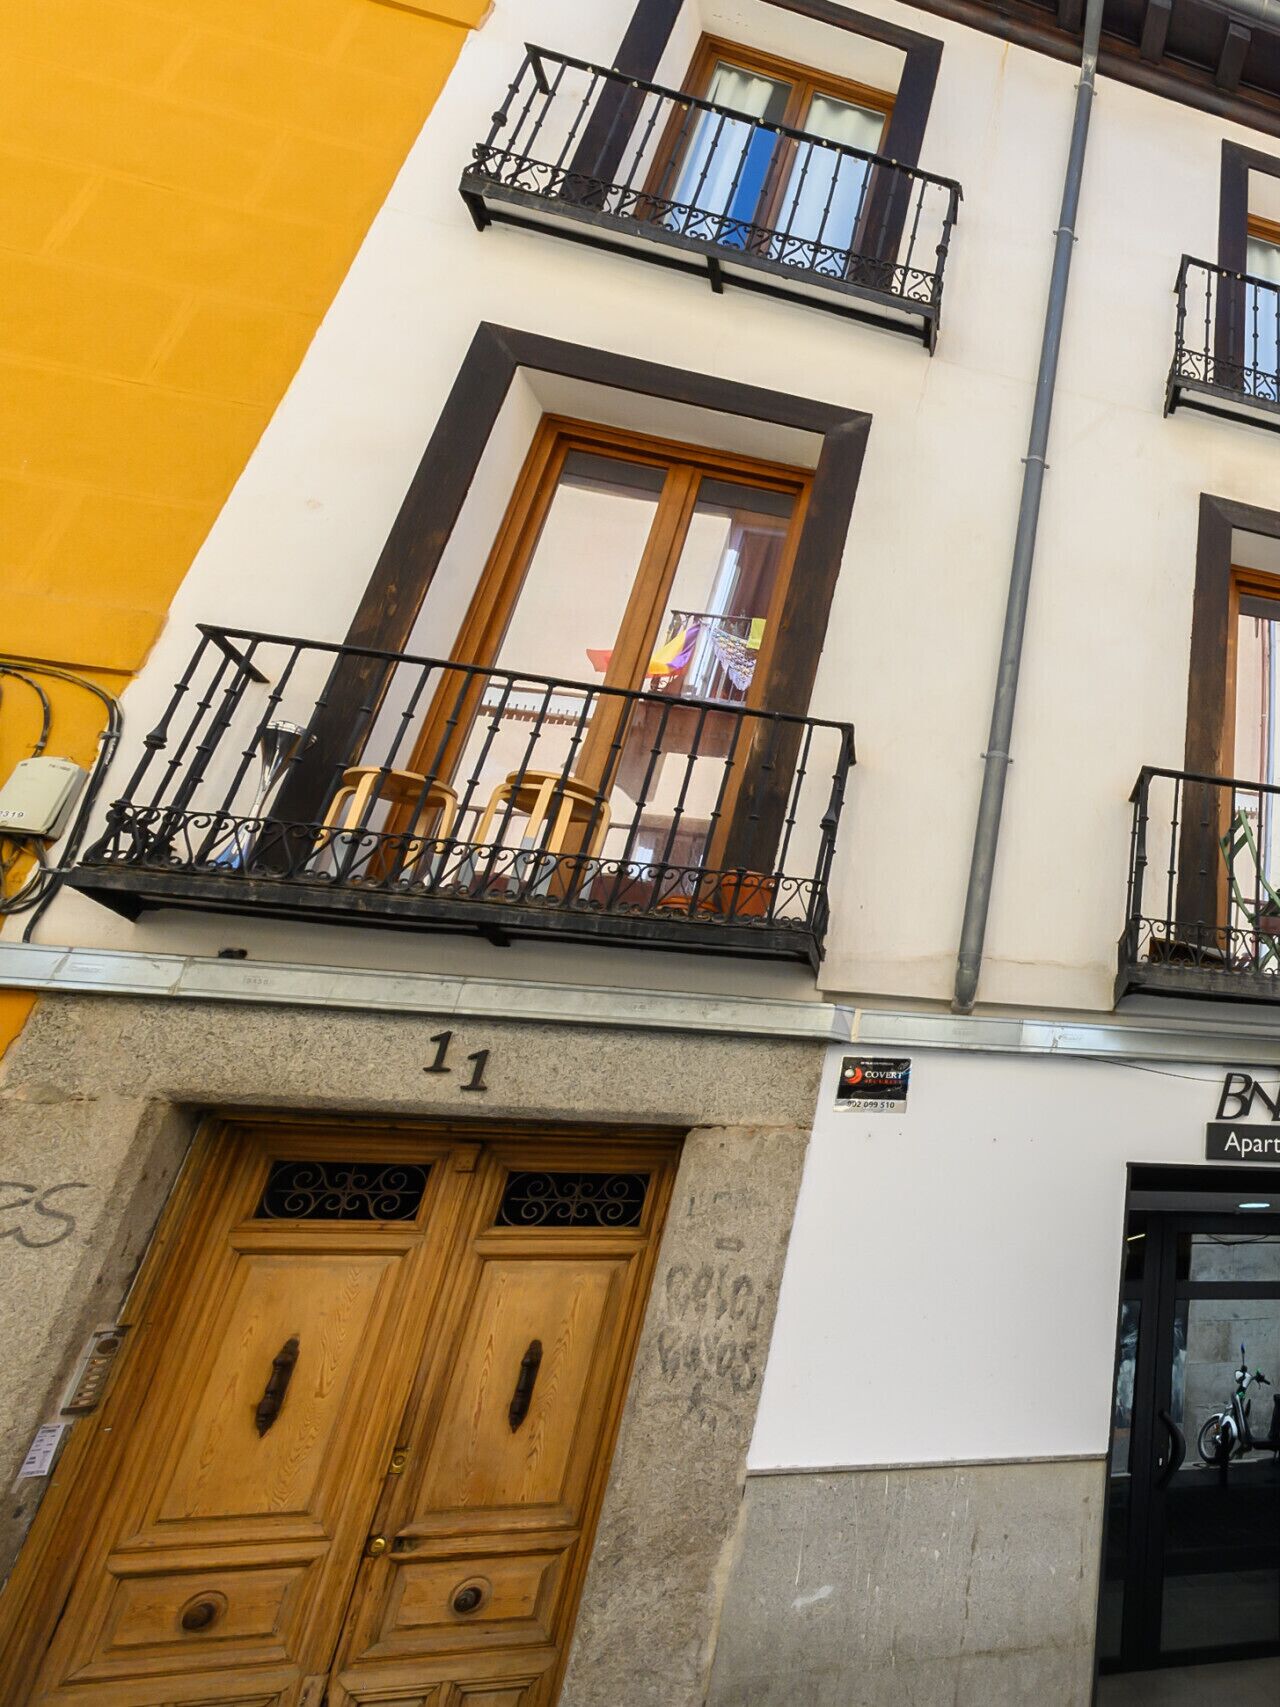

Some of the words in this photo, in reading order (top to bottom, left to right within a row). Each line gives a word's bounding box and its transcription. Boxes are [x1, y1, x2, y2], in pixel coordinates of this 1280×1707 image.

[423, 1030, 490, 1091] 11
[864, 1070, 902, 1079] COVERT
[863, 1100, 878, 1108] 099
[880, 1101, 895, 1109] 510
